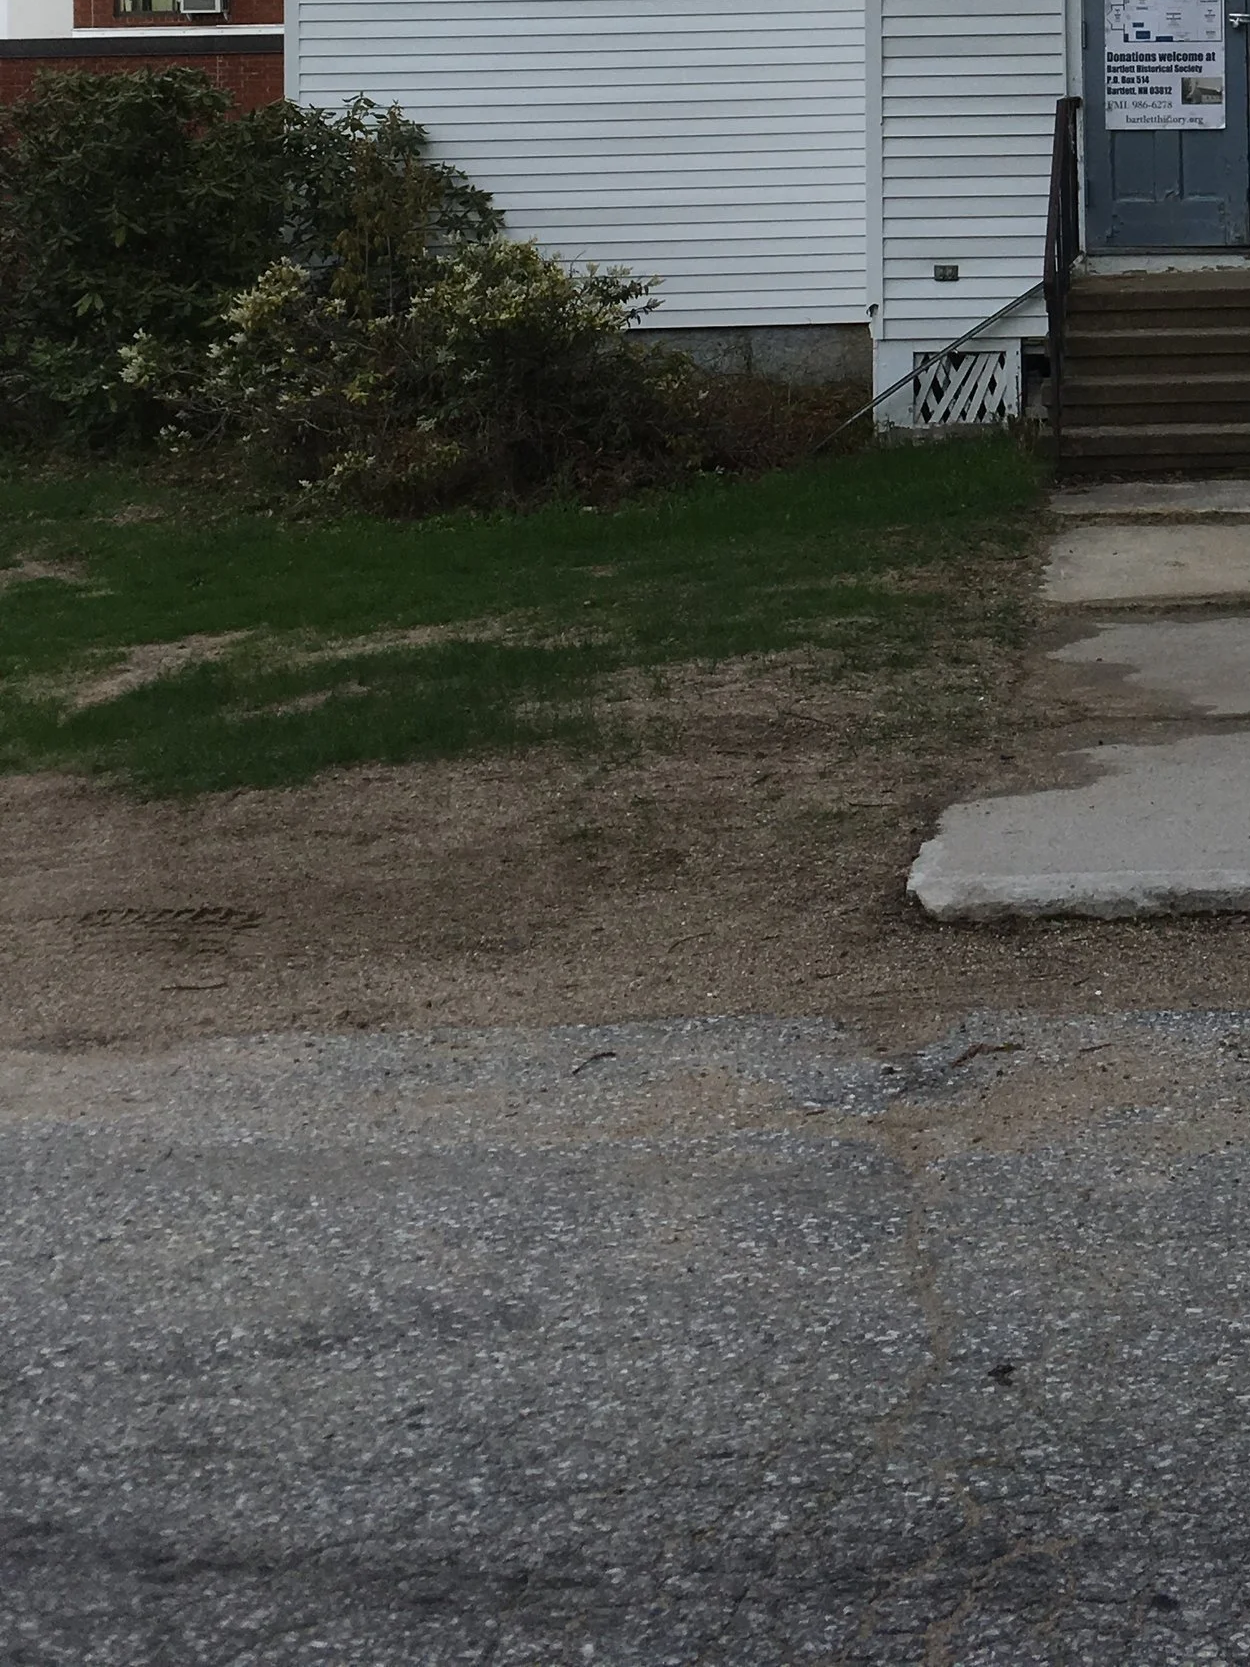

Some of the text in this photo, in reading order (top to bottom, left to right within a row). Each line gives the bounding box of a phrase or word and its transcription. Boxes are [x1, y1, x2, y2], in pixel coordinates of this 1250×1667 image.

[1107, 52, 1216, 62] Donations welcome at
[1107, 65, 1202, 74] Bartlett Historical Society
[1107, 76, 1150, 84] P.O. Box 514
[1107, 87, 1136, 95] Bartlett,
[1150, 87, 1172, 95] 03812
[1132, 100, 1173, 109] 986-6278
